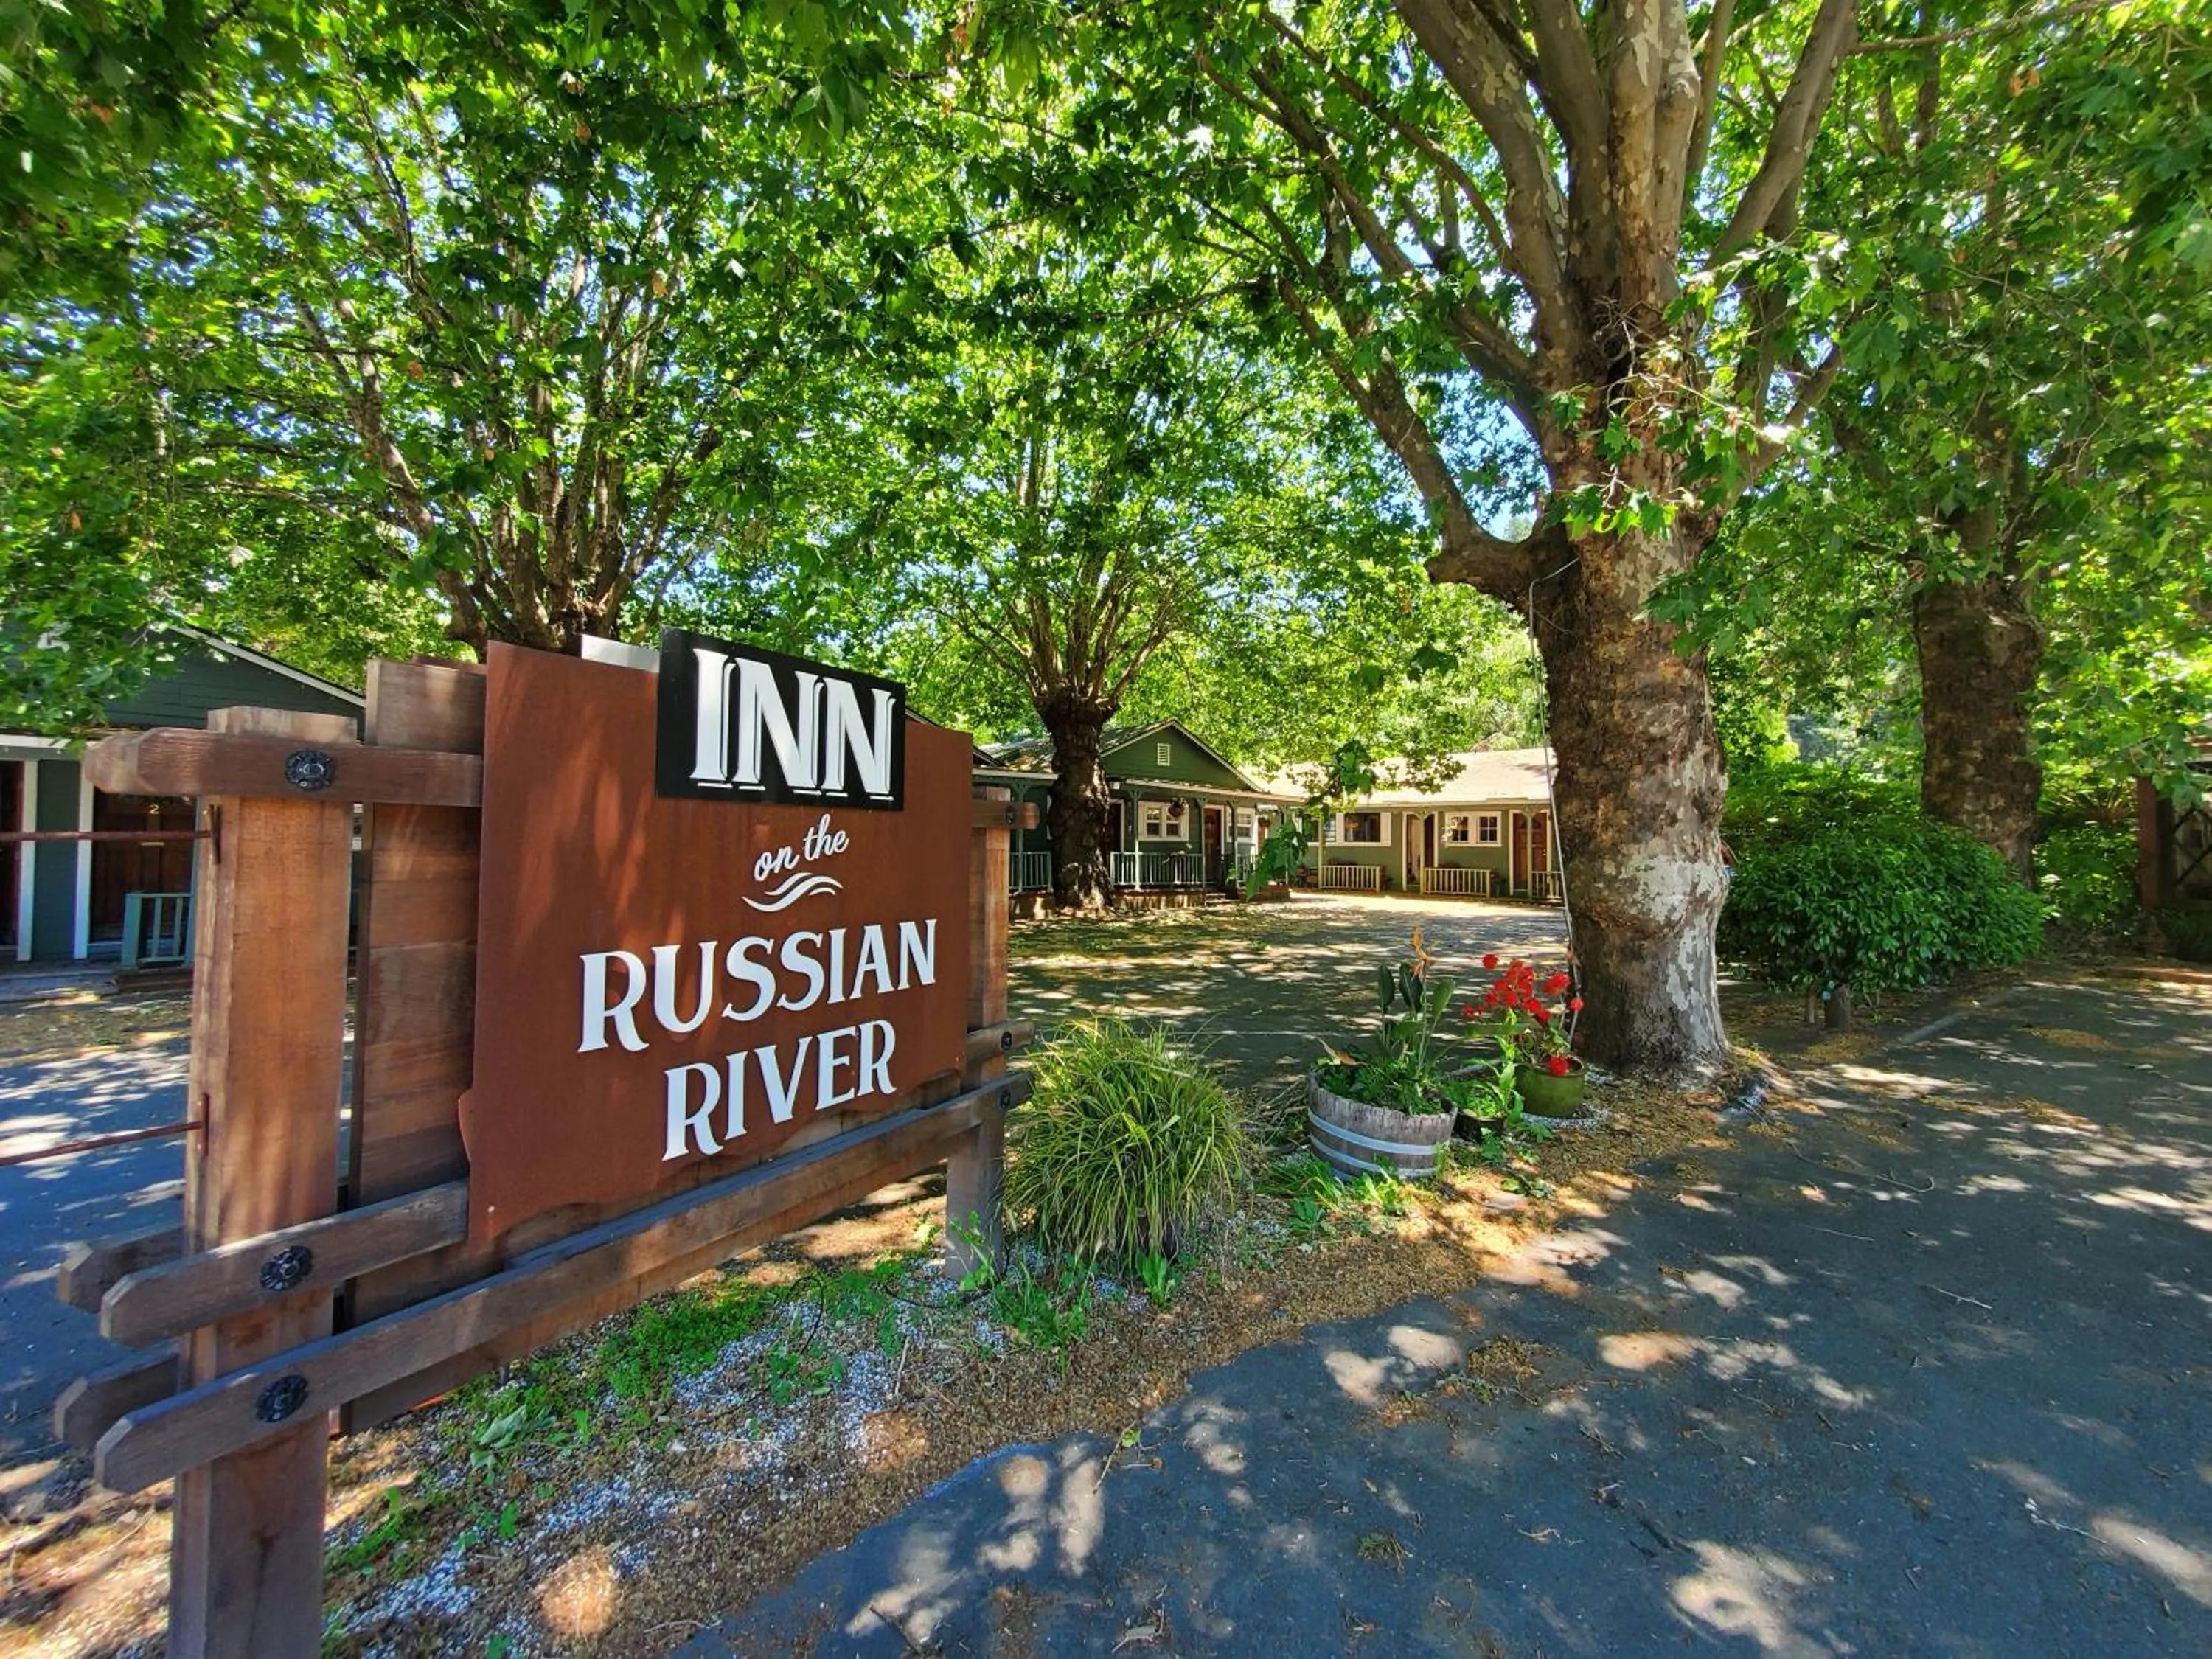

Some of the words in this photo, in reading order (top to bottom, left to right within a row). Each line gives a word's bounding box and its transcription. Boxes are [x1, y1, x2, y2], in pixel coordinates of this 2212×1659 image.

[689, 647, 895, 801] INN
[149, 804, 160, 815] 2
[754, 846, 799, 882] on
[801, 813, 849, 862] the
[577, 919, 937, 1053] RUSSIAN
[661, 1020, 897, 1162] RIVER
